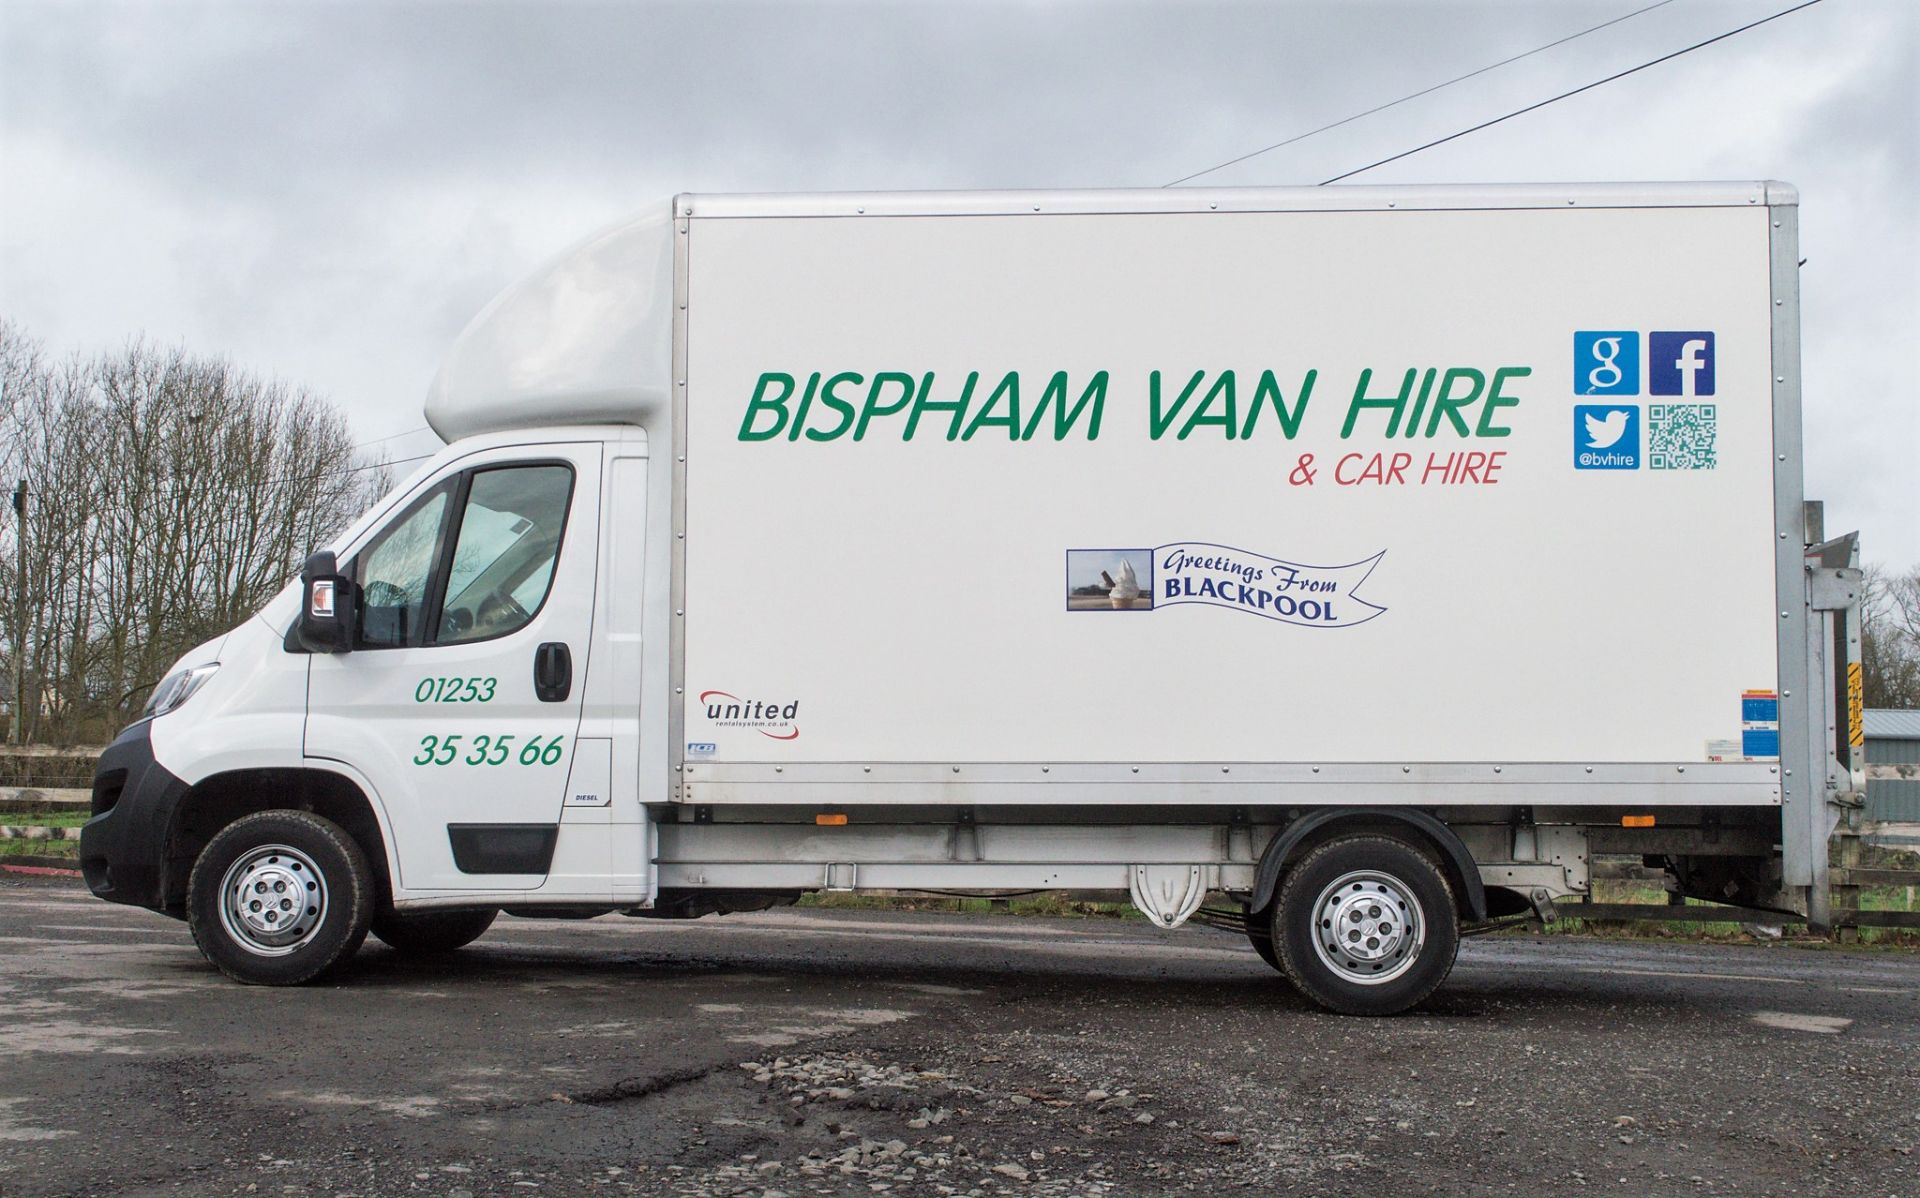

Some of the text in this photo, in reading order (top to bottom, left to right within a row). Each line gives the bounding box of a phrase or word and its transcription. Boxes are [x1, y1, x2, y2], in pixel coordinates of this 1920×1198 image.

[737, 366, 1533, 443] BISPHAM VAN HIRE
[1288, 451, 1508, 487] & CAR HIRE
[1579, 452, 1634, 467] @bvhire
[1163, 549, 1337, 593] Greetings From
[1165, 576, 1338, 621] BLACKPOOL
[415, 677, 498, 703] 01253
[706, 700, 799, 720] united
[715, 720, 789, 728] rentalsystem.co.uk
[412, 735, 565, 766] 35 35 66
[575, 794, 599, 802] DIESEL
